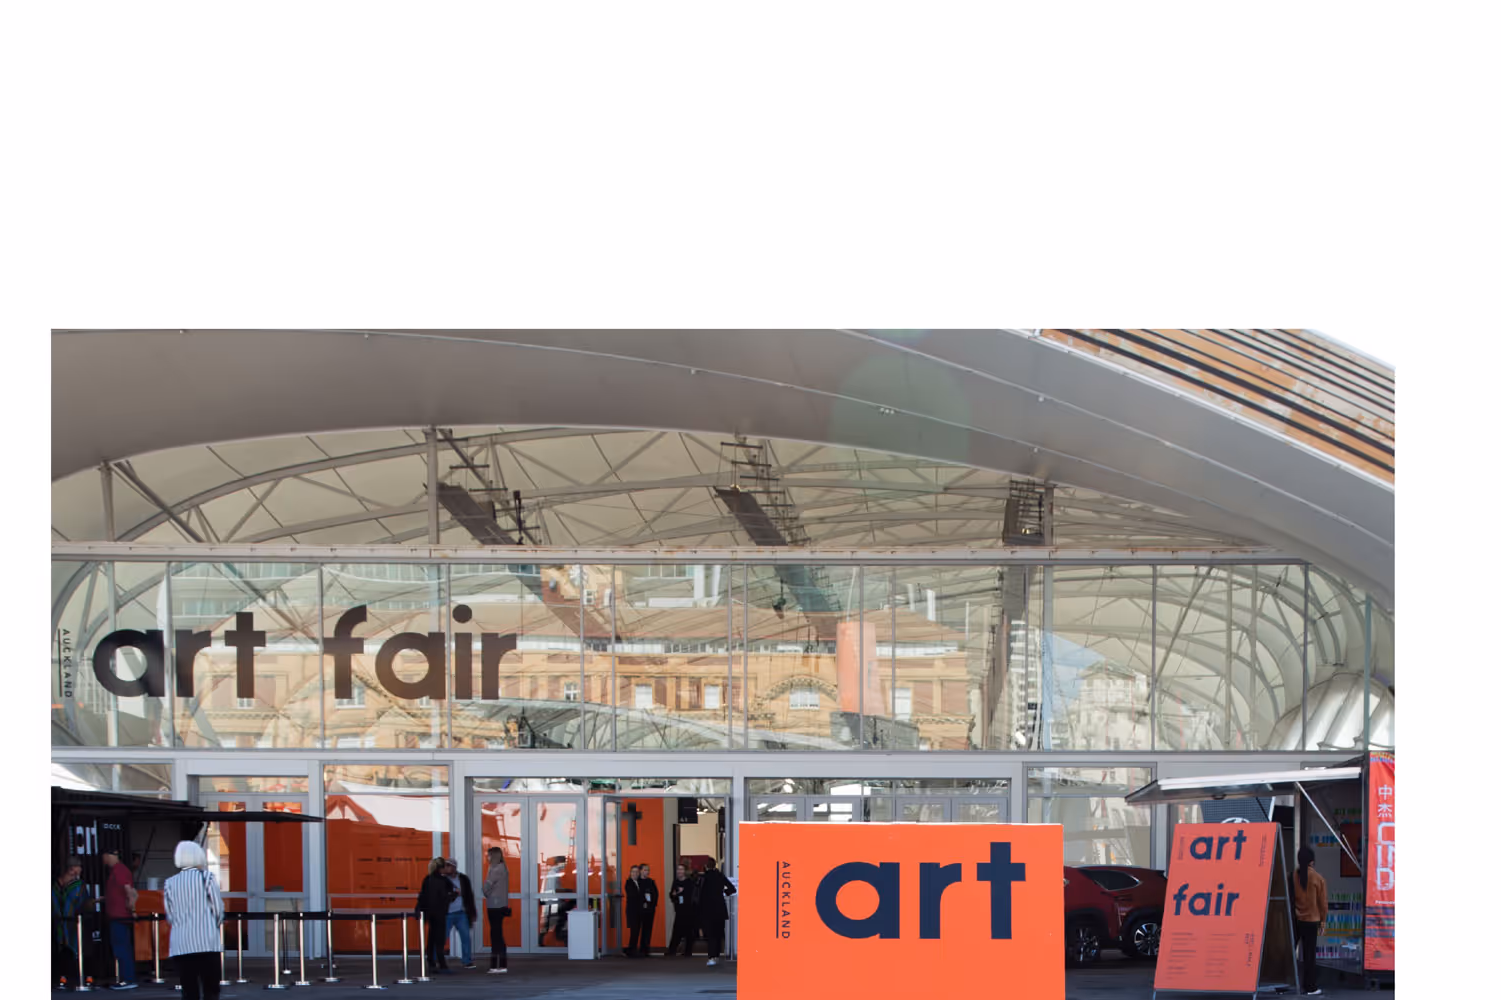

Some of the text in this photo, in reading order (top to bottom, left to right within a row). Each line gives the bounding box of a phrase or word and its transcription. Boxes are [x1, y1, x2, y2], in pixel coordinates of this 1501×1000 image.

[62, 628, 72, 699] AUCKLAND
[92, 603, 518, 700] art fair
[1189, 829, 1247, 860] art
[781, 860, 791, 940] AUCKLAND
[815, 841, 1027, 940] art
[1173, 883, 1239, 916] fair
